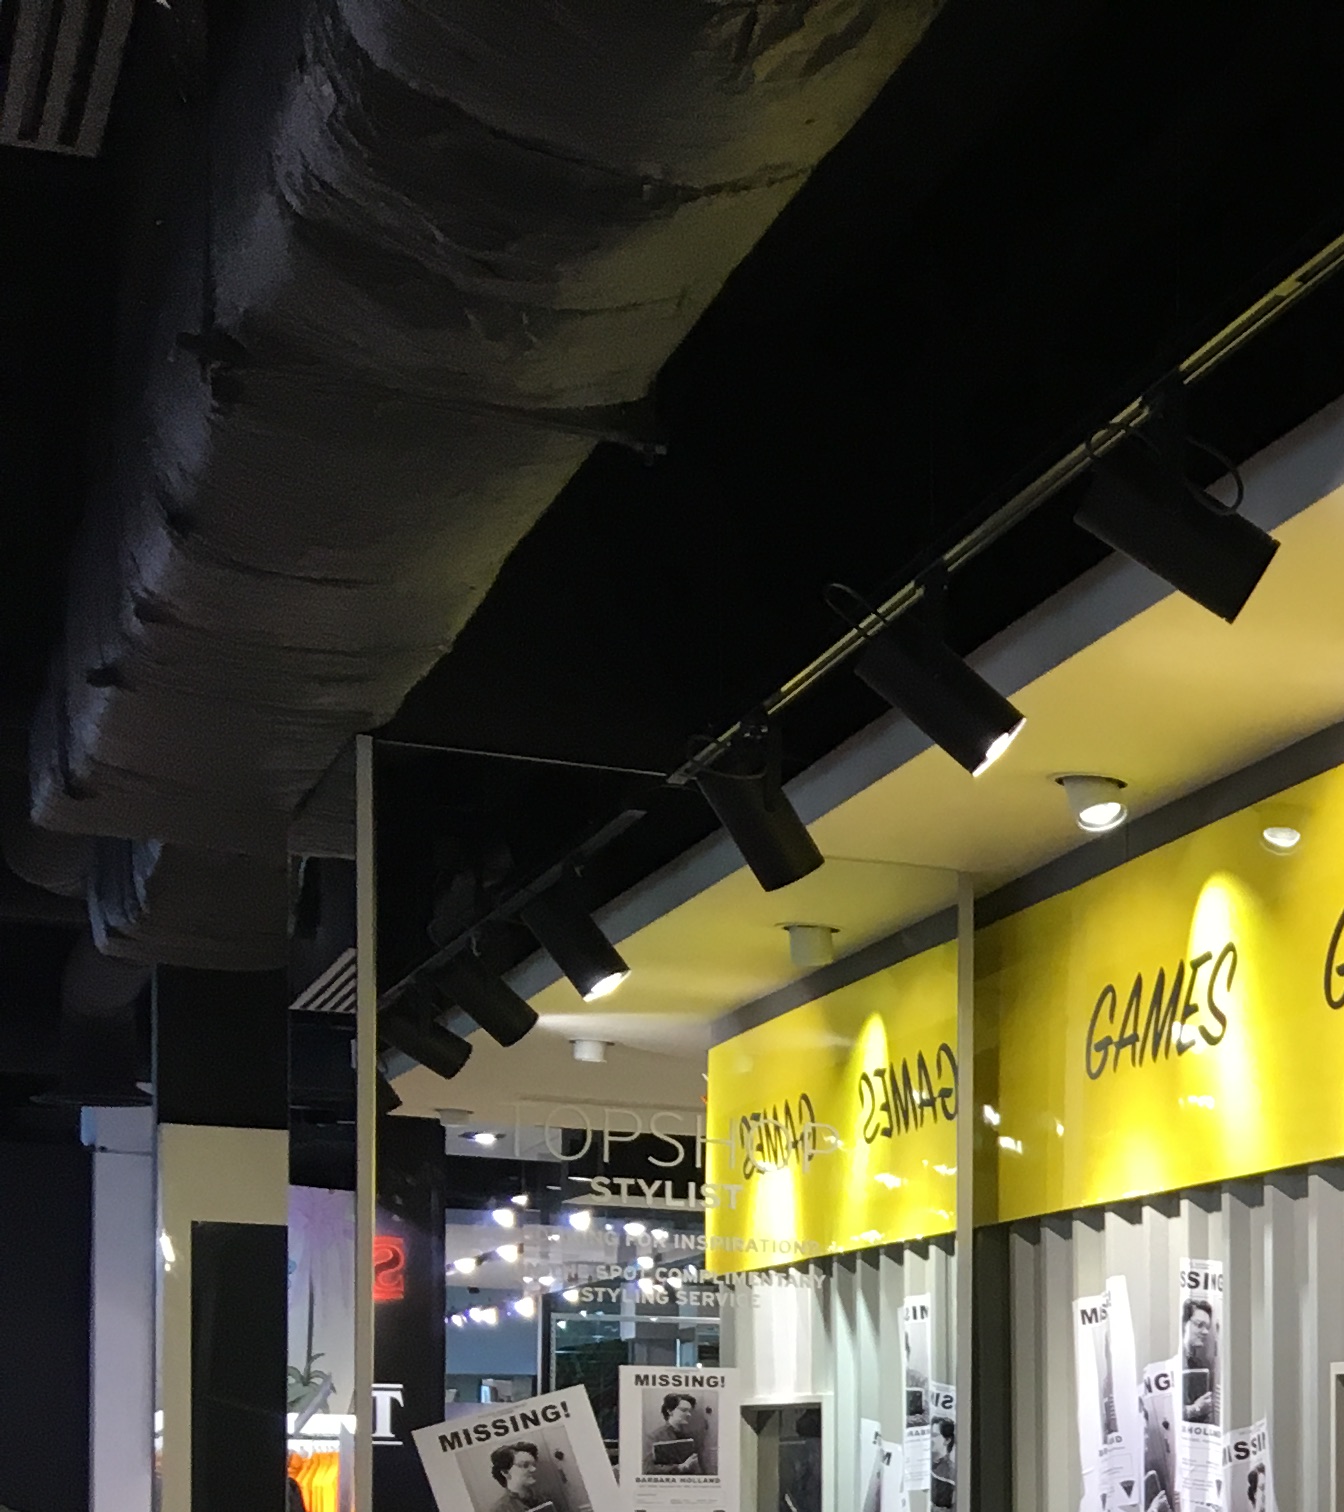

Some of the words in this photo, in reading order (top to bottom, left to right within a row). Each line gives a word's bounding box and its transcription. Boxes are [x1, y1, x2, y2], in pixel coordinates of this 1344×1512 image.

[1085, 941, 1238, 1081] GAMES
[504, 1102, 840, 1174] TOPSHOP
[590, 1176, 744, 1211] STYLIST
[634, 1373, 726, 1389] MISSING!
[438, 1401, 571, 1453] MISSING!
